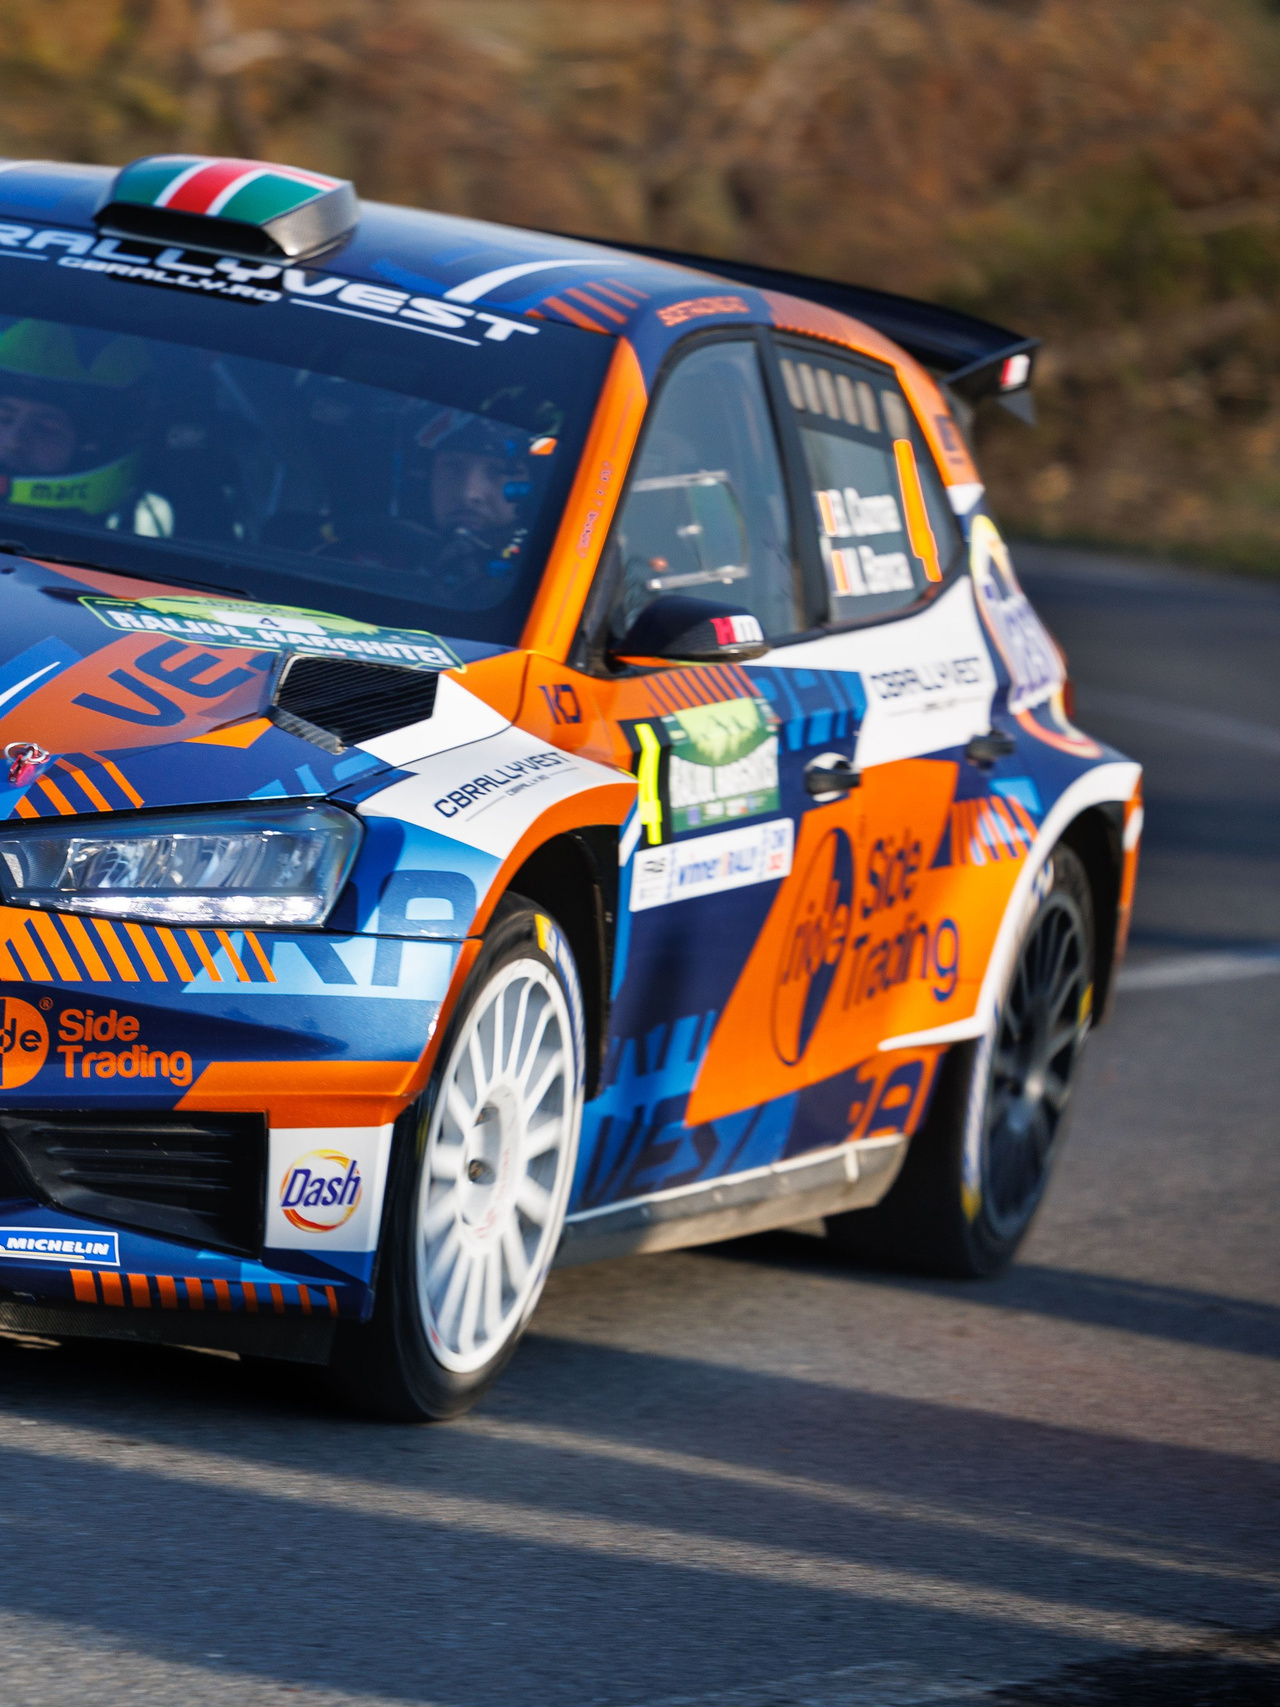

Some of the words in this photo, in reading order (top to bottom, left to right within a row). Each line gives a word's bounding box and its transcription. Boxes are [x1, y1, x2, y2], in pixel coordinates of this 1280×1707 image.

[57, 256, 283, 302] CBRALLY.RO
[106, 609, 253, 640] RALIUL
[258, 629, 457, 667] HARGHITEI
[433, 751, 571, 819] CBRALLYVEST
[57, 1008, 141, 1042] Side
[56, 1045, 194, 1087] Trading
[280, 1159, 362, 1208] Dash
[6, 1236, 110, 1256] MICHELIN
